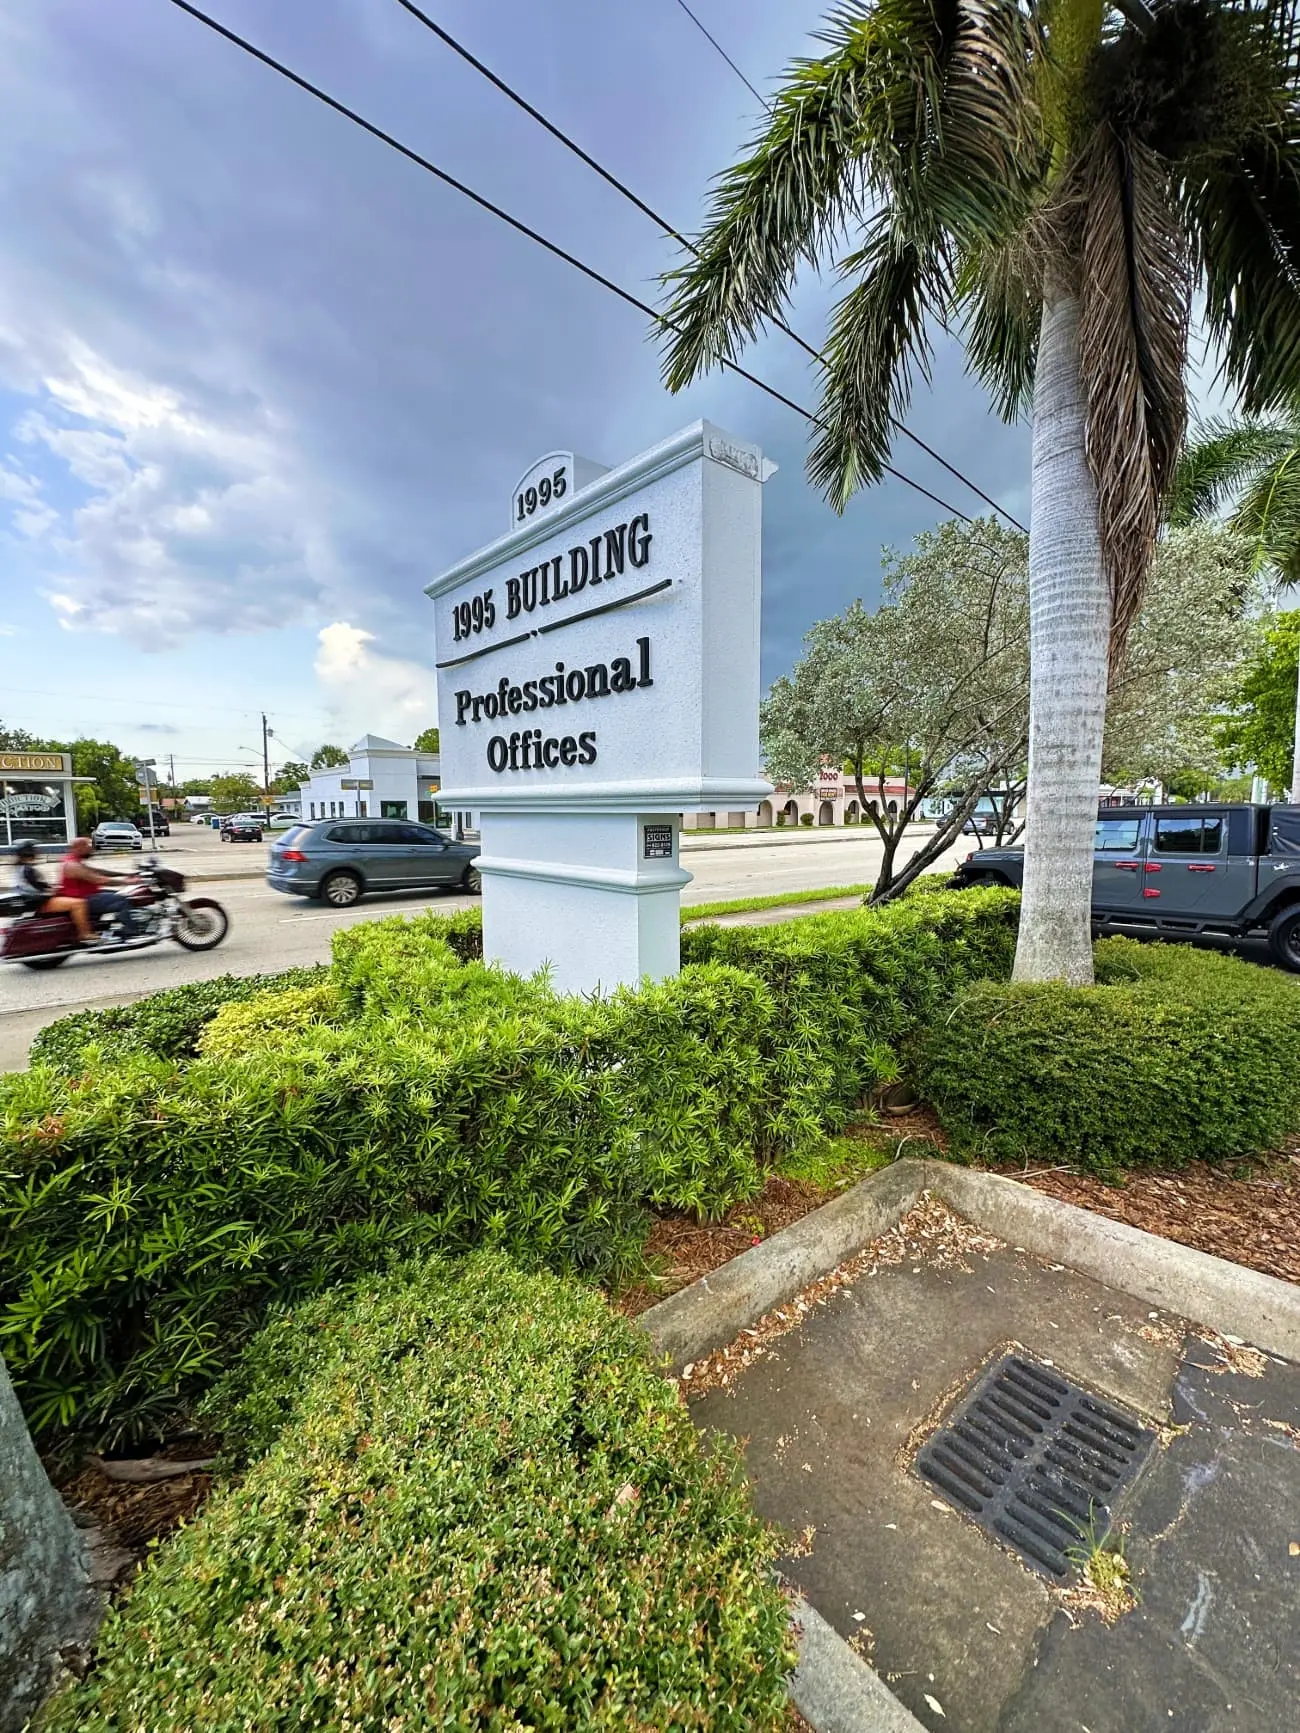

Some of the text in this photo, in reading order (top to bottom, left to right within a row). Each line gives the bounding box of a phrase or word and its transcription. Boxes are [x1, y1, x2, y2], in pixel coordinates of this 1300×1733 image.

[517, 466, 567, 521] 1995
[452, 513, 653, 642] 1995 BUILDING
[454, 637, 654, 726] Professional
[1, 756, 56, 769] CTION
[486, 729, 598, 773] Offices
[647, 833, 671, 841] SIGNS
